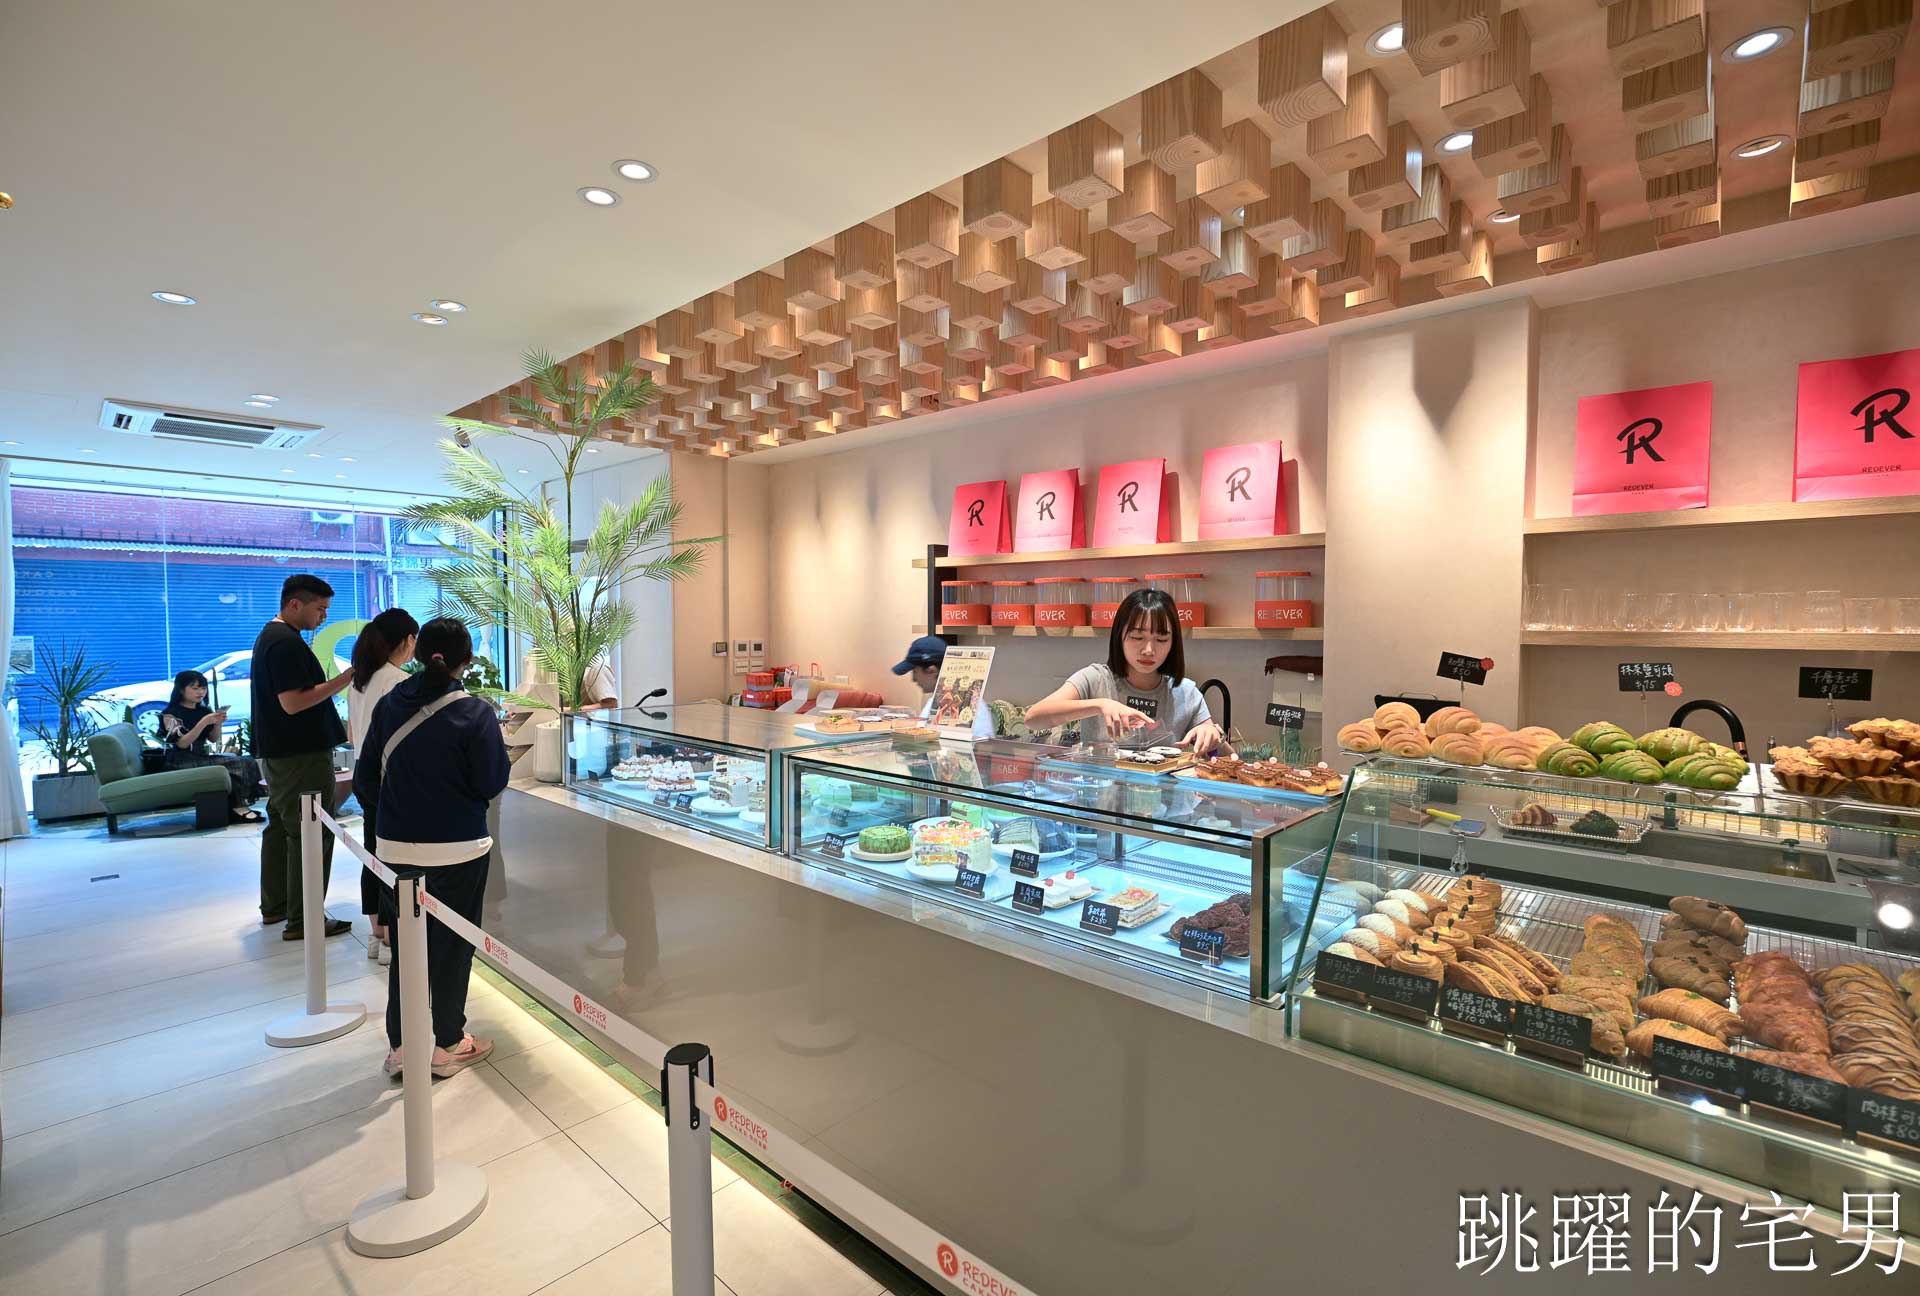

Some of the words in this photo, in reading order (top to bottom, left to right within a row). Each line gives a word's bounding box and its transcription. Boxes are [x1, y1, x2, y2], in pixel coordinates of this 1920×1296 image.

[1850, 388, 1916, 443] R
[1616, 417, 1665, 464] R
[1679, 1063, 1715, 1080] $100
[729, 1107, 768, 1143] REDEVER
[1861, 1100, 1920, 1126] 肉桂可
[1881, 1122, 1920, 1140] $80
